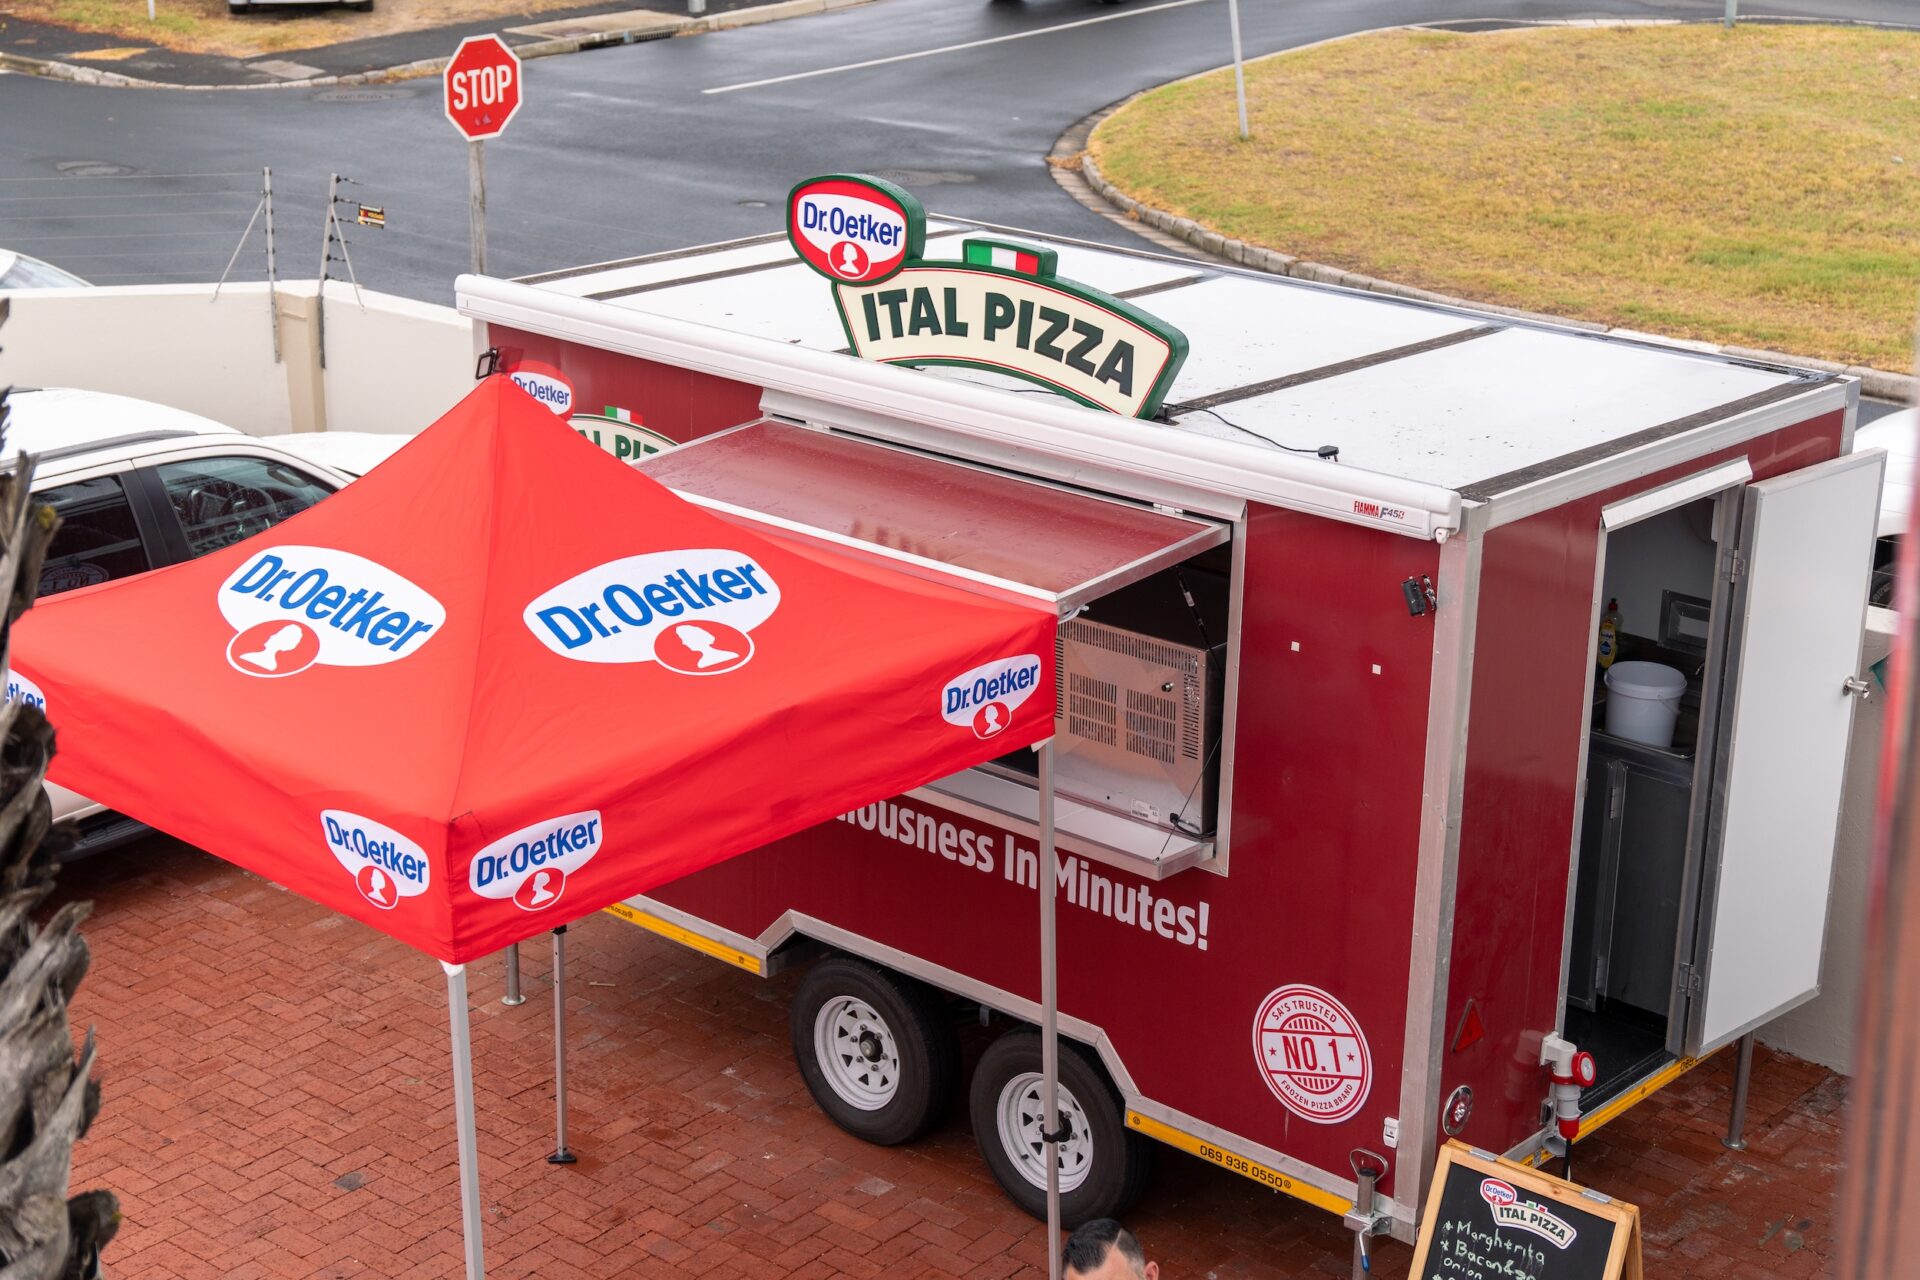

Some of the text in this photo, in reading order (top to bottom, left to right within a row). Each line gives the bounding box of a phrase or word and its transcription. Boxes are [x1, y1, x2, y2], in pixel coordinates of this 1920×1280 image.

[452, 64, 512, 111] STOP
[861, 286, 1135, 398] ITAL PIZZA
[1353, 500, 1379, 518] FIAMMA
[836, 800, 1210, 951] ousness In Minutes!
[1271, 1000, 1338, 1023] SA'S TRUSTED
[1281, 1079, 1353, 1110] FROZEN PIZZA BRAND
[1200, 1145, 1223, 1162] 069
[1225, 1155, 1249, 1173] 936
[1500, 1207, 1567, 1241] ITAL PIZZA
